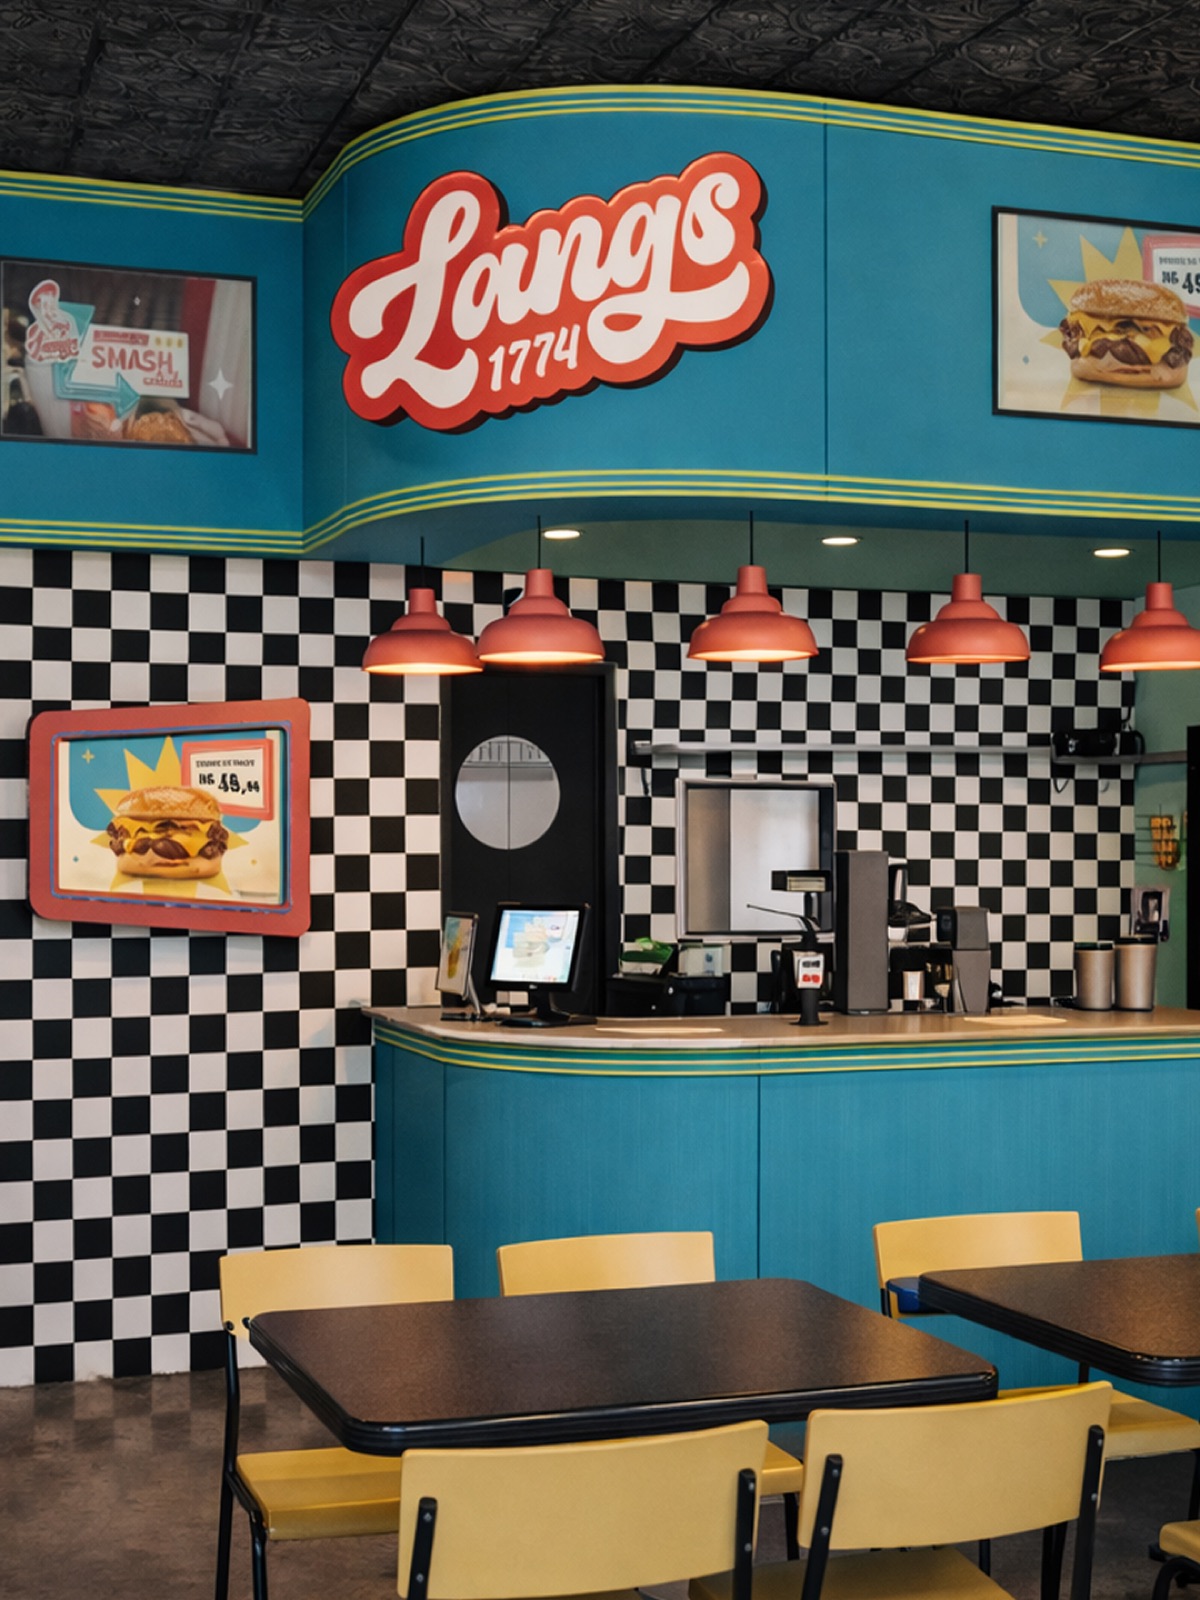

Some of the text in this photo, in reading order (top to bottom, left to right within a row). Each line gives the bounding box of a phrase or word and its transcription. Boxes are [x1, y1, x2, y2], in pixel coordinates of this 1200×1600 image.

[349, 172, 750, 409] Langs
[91, 345, 173, 375] SMASH
[488, 324, 580, 392] 1774
